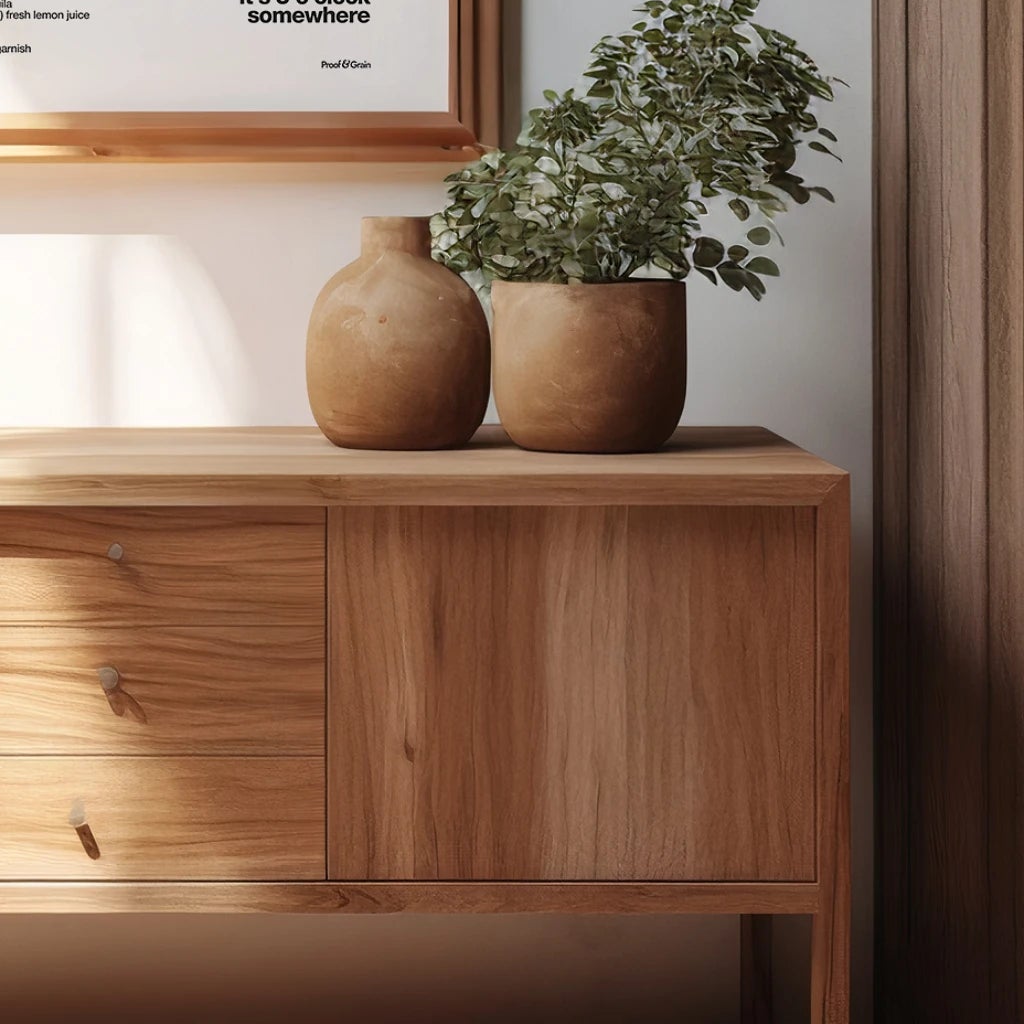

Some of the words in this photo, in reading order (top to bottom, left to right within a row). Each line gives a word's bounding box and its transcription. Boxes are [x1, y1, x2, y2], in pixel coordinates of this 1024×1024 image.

[5, 9, 32, 20] fresh
[32, 9, 65, 20] lemon
[65, 9, 91, 22] juice
[247, 5, 371, 24] somewhere
